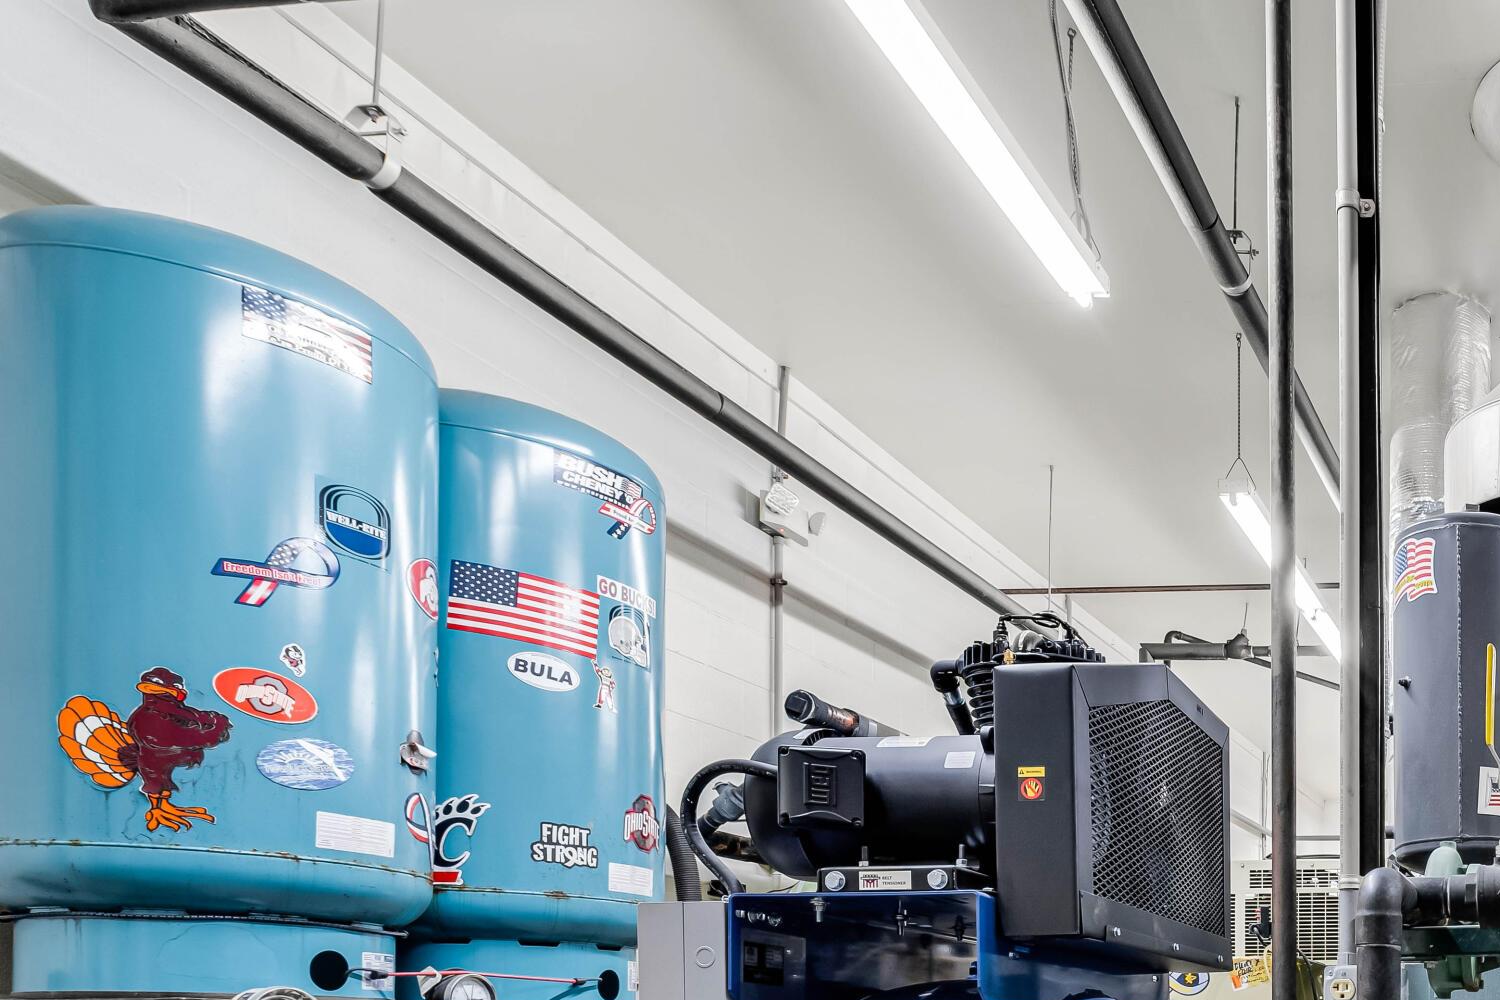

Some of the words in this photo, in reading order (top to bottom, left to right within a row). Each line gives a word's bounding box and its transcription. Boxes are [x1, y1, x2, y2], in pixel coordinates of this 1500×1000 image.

[558, 452, 624, 490] BUSH
[562, 470, 624, 501] CHENEY
[326, 511, 387, 539] WELL-RITE
[223, 561, 273, 578] Freedom
[599, 578, 618, 598] GO
[621, 584, 656, 617] BUCKS!
[513, 658, 573, 686] BULA
[541, 823, 590, 847] FIGHT
[624, 812, 643, 841] OHIO
[532, 843, 598, 868] STRONG
